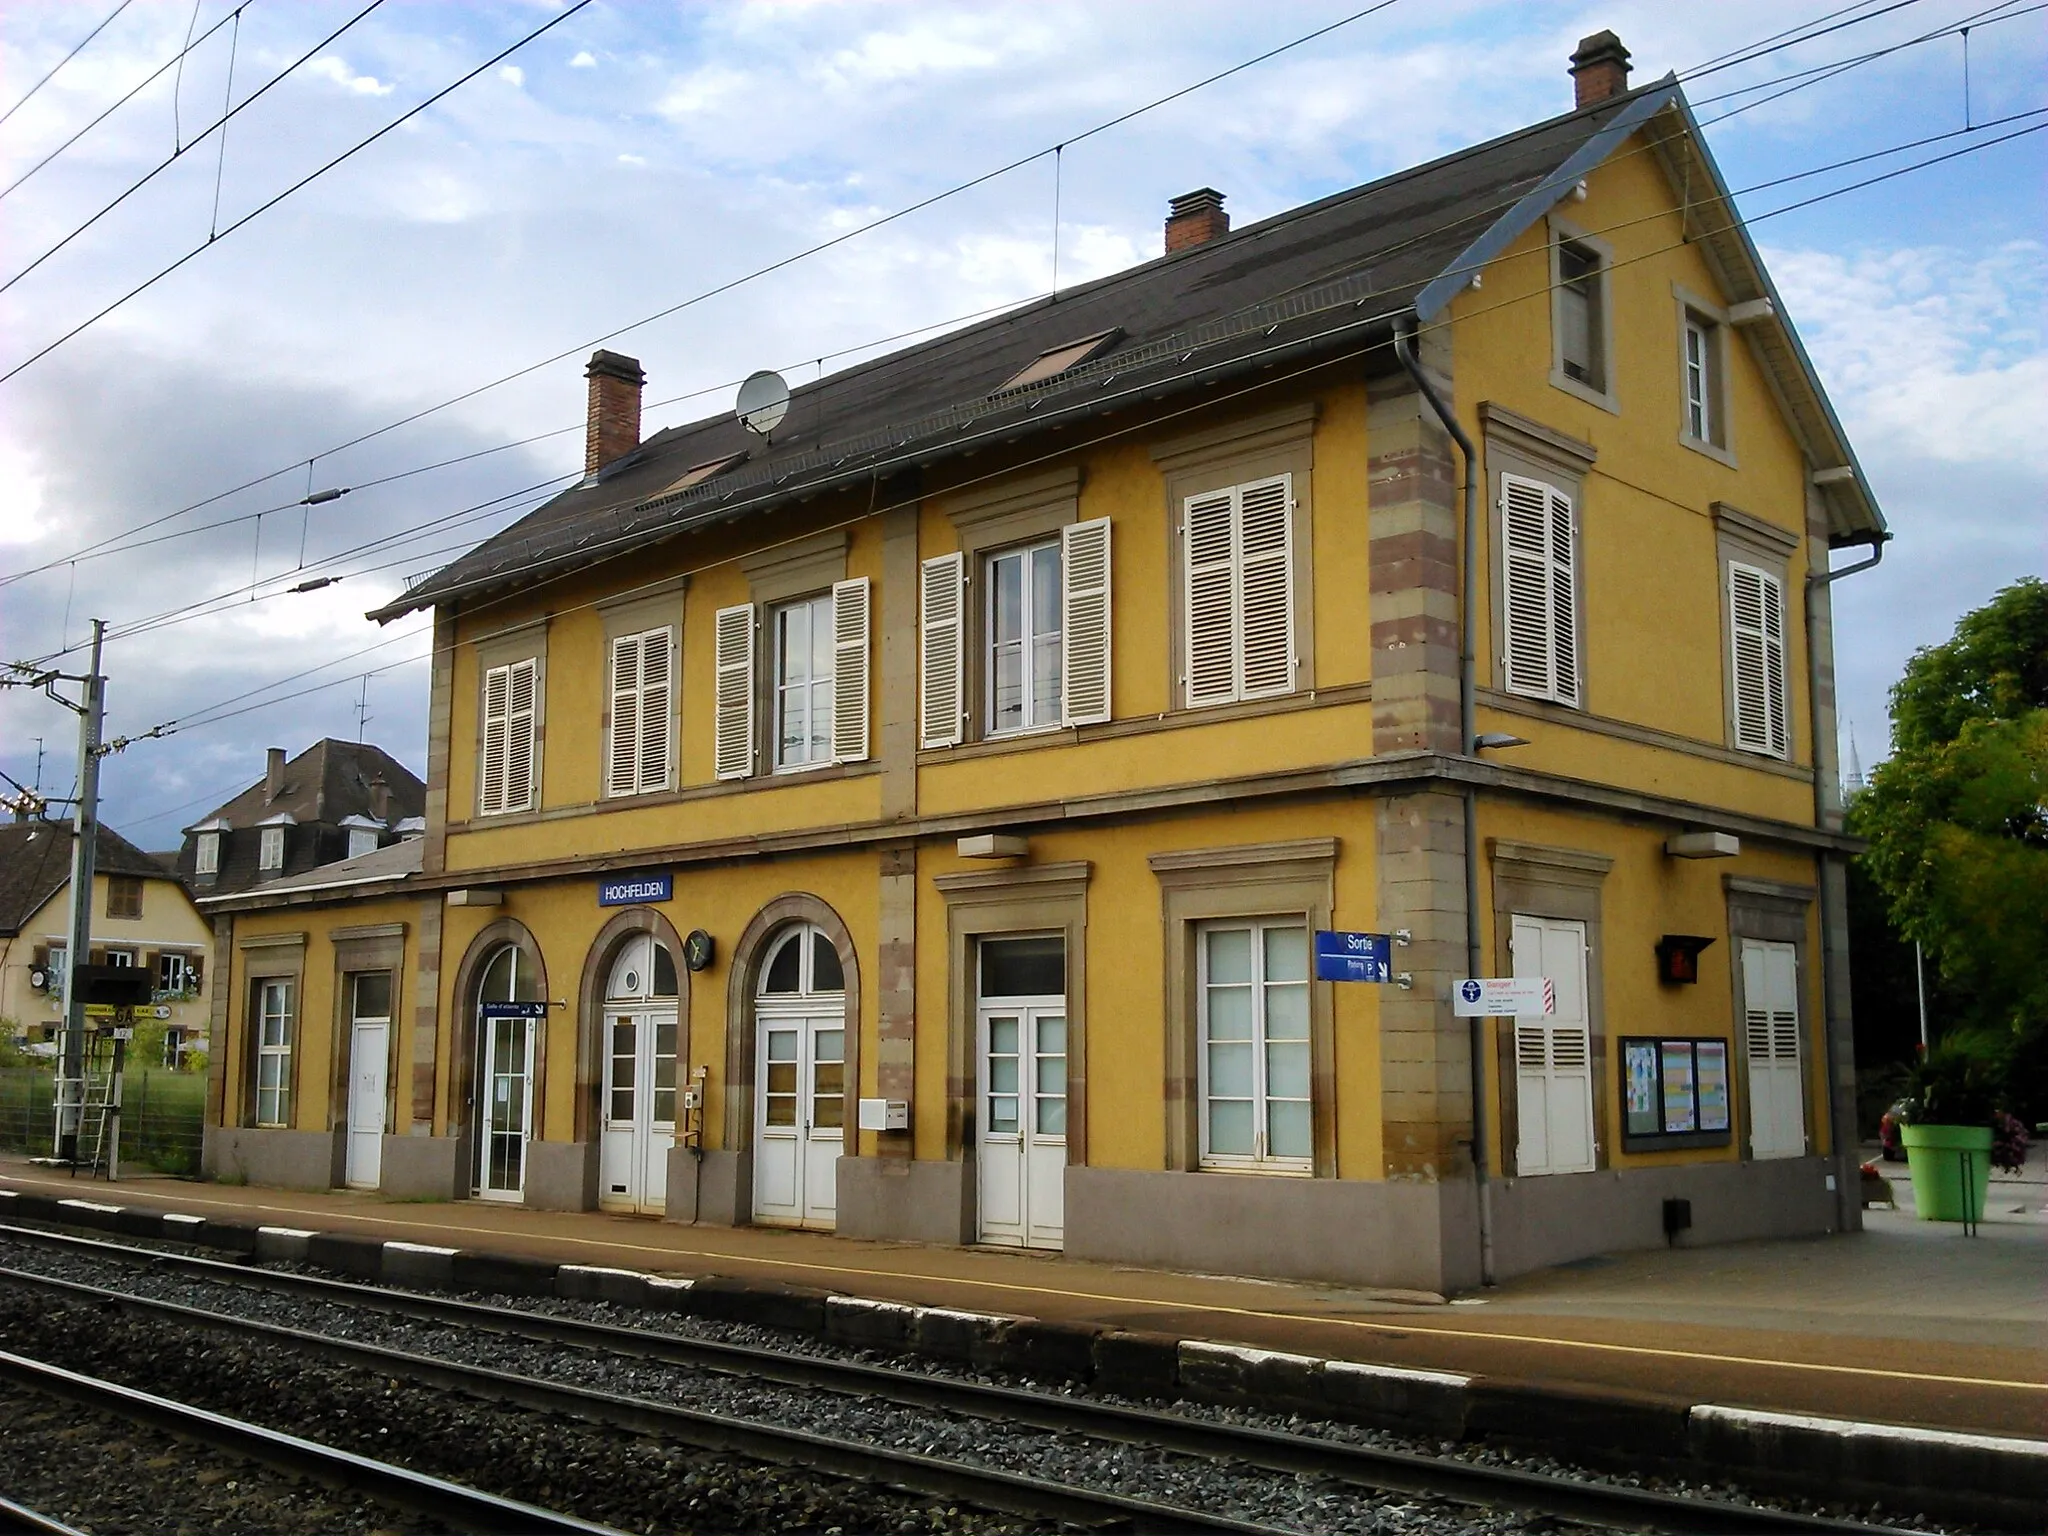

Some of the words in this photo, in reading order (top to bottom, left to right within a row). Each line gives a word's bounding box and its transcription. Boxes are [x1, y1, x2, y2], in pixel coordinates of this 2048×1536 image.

[605, 882, 664, 900] HOCHFELDEN
[1347, 934, 1373, 951] Sortie
[1486, 981, 1511, 989] Danger
